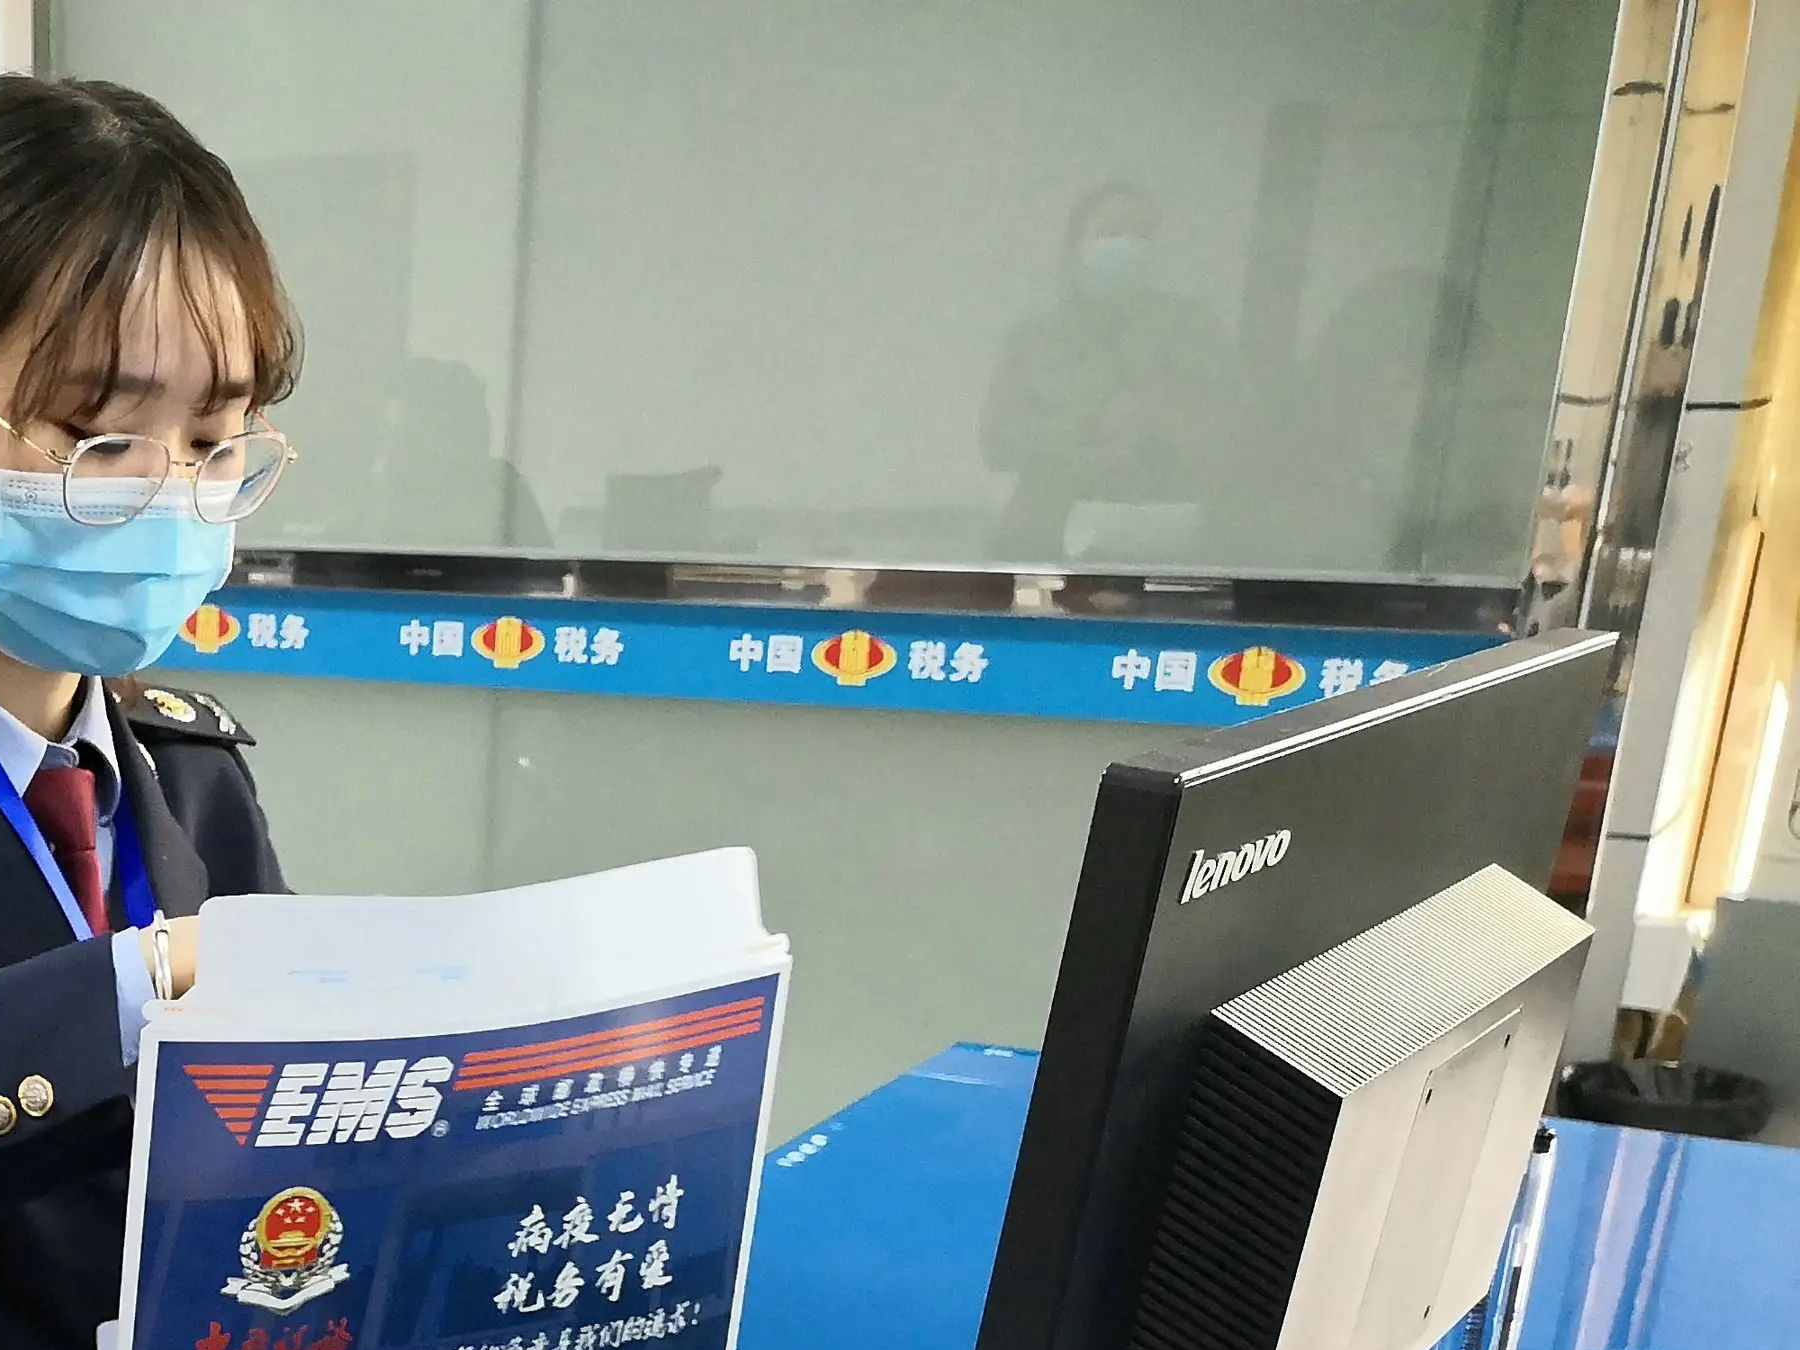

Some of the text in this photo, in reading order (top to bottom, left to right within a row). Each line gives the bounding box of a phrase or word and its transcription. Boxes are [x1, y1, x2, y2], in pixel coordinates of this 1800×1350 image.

[247, 613, 310, 650] 税务
[400, 619, 625, 667] 中国 税务
[728, 632, 991, 685] 中国 税务
[1111, 648, 1198, 693] 中国
[1179, 828, 1293, 905] lenovo
[253, 1055, 454, 1147] EMS
